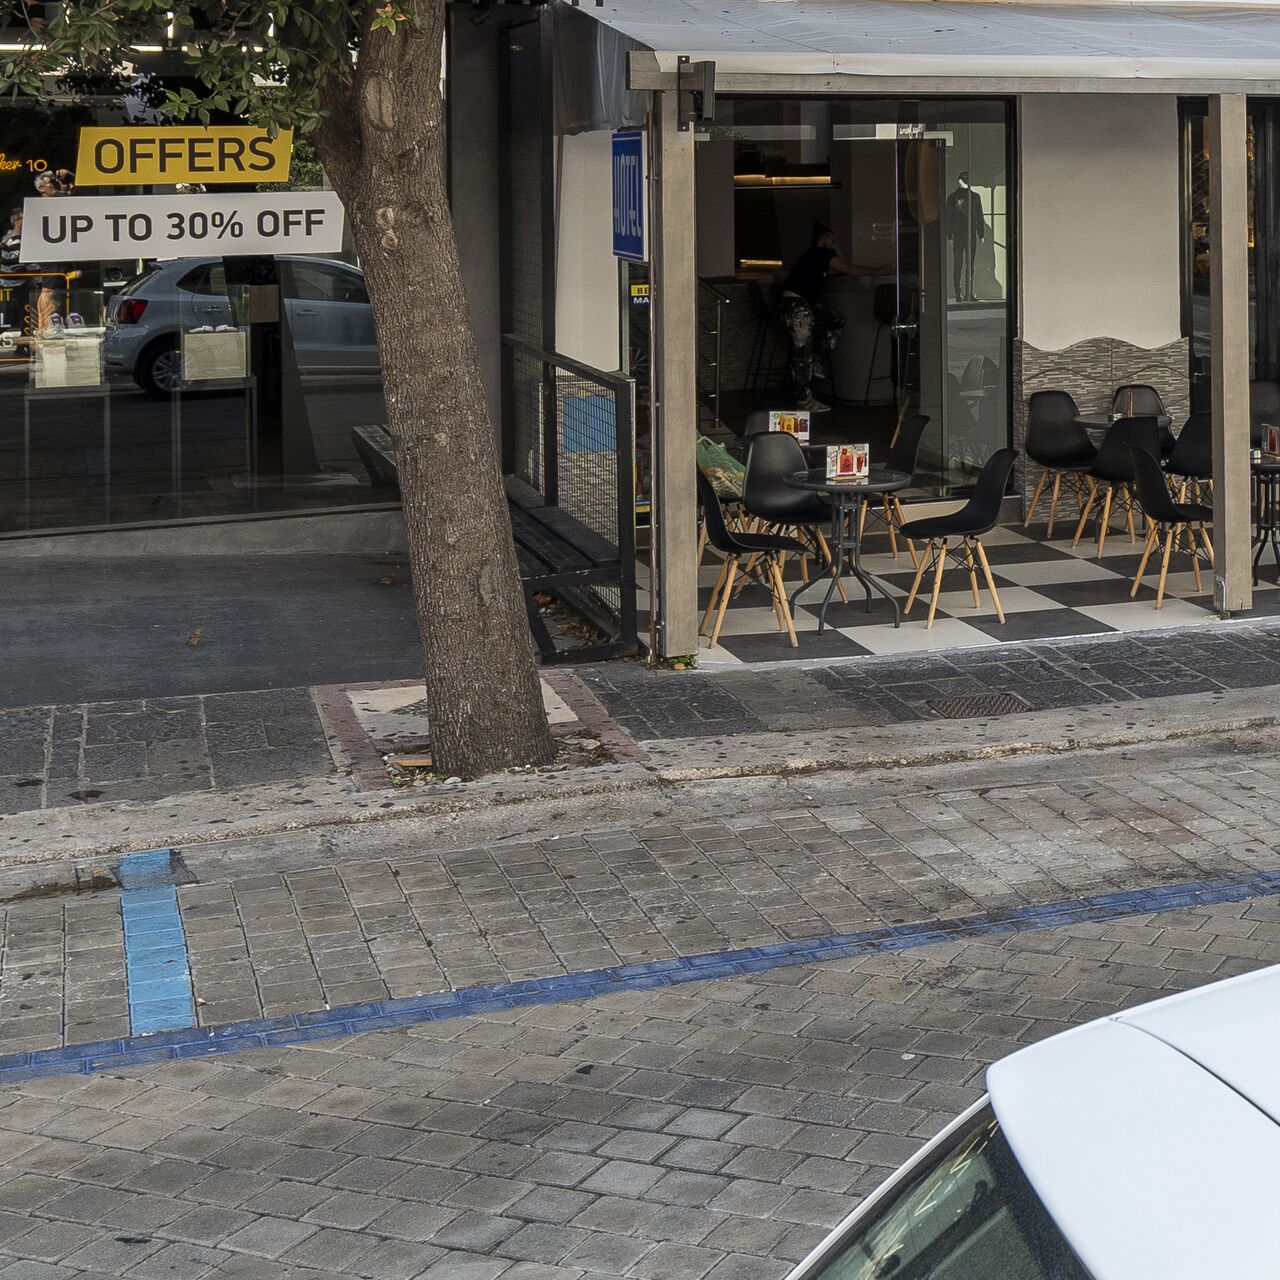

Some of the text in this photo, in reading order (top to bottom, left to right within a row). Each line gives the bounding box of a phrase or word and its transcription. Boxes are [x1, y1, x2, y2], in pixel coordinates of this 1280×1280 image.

[26, 159, 48, 172] 10
[94, 137, 277, 175] OFFERS
[614, 153, 642, 237] HOTEL
[42, 209, 326, 244] UP TO 30% OFF
